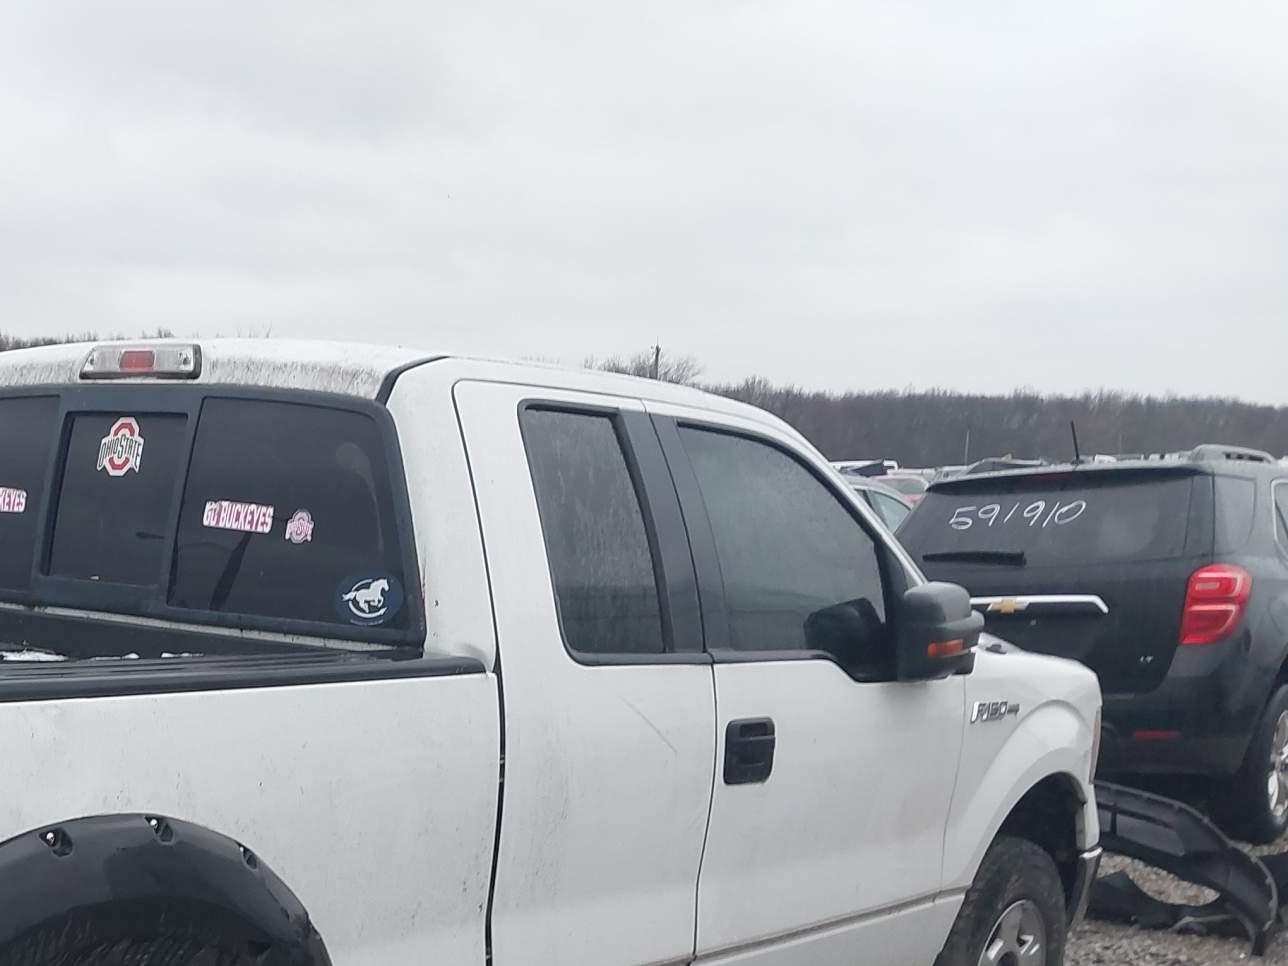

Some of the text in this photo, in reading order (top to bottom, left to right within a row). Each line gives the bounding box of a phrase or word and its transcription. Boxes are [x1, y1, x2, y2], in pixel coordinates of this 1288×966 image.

[203, 500, 219, 527] GO
[219, 502, 274, 533] BUCKEYES
[948, 500, 1087, 530] 591910
